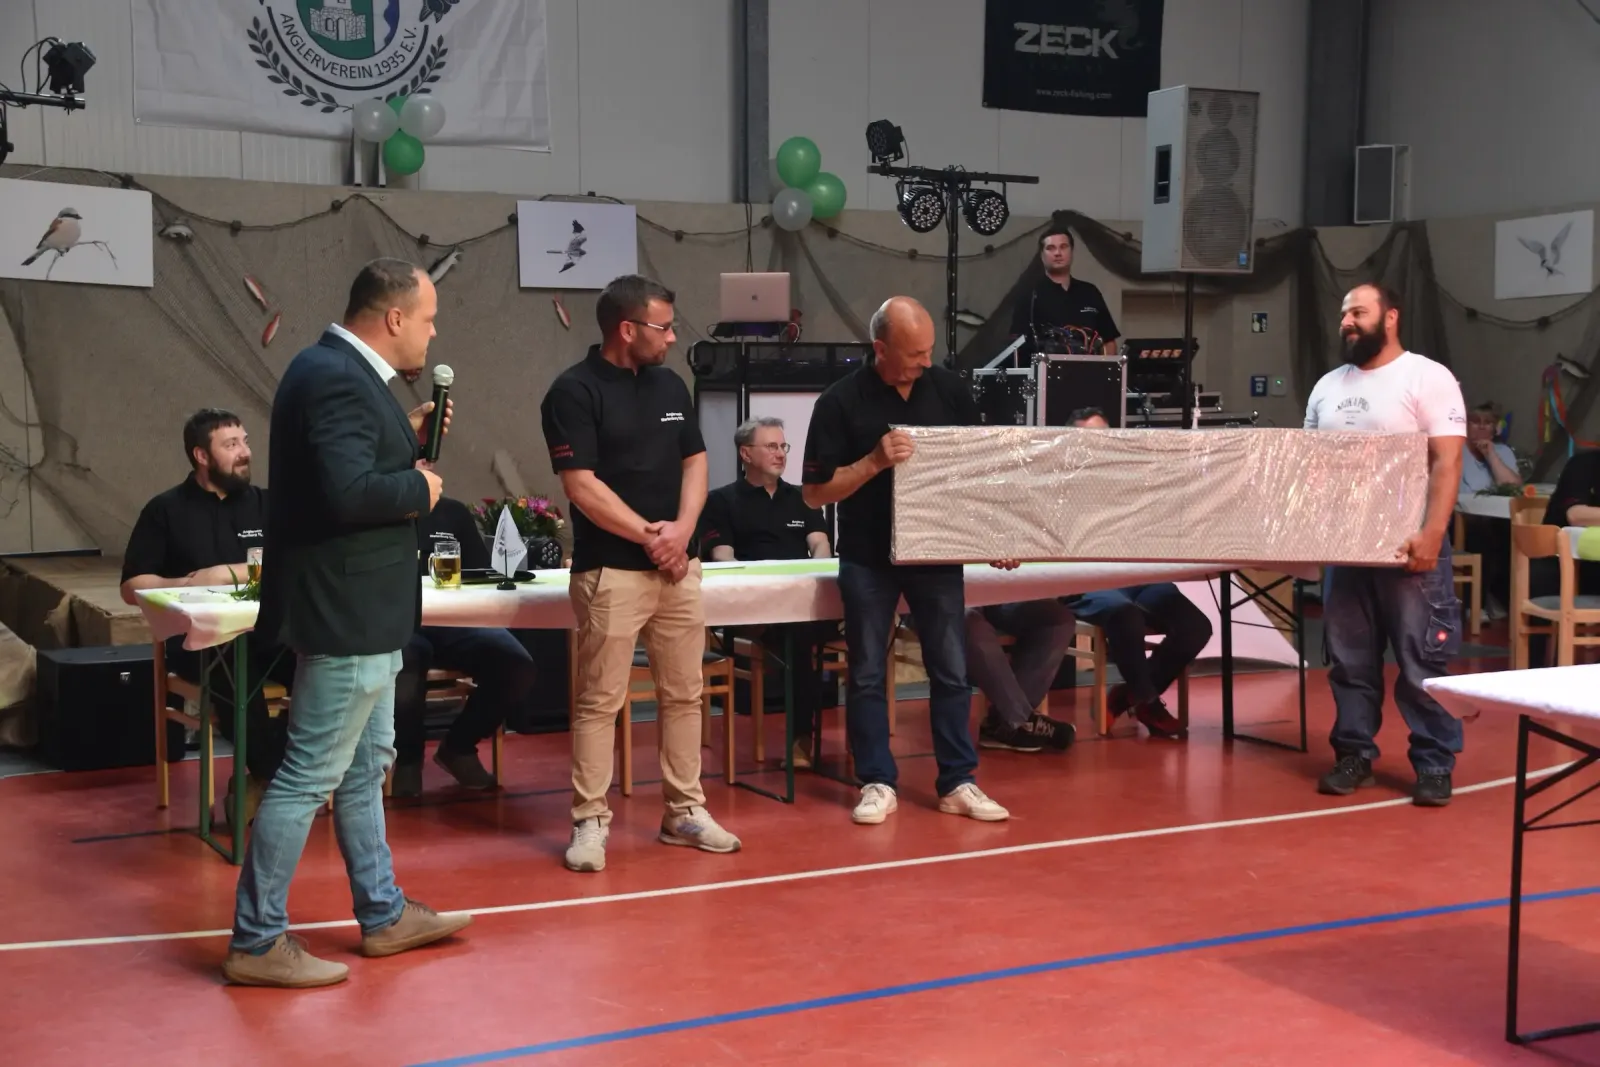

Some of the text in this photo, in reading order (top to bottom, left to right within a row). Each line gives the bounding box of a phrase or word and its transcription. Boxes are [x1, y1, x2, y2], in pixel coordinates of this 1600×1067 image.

[280, 13, 417, 79] ANGLERVEREIN 1935 E.V.
[1013, 21, 1120, 59] ZECK
[1036, 88, 1113, 101] www.zeck-fishing.com
